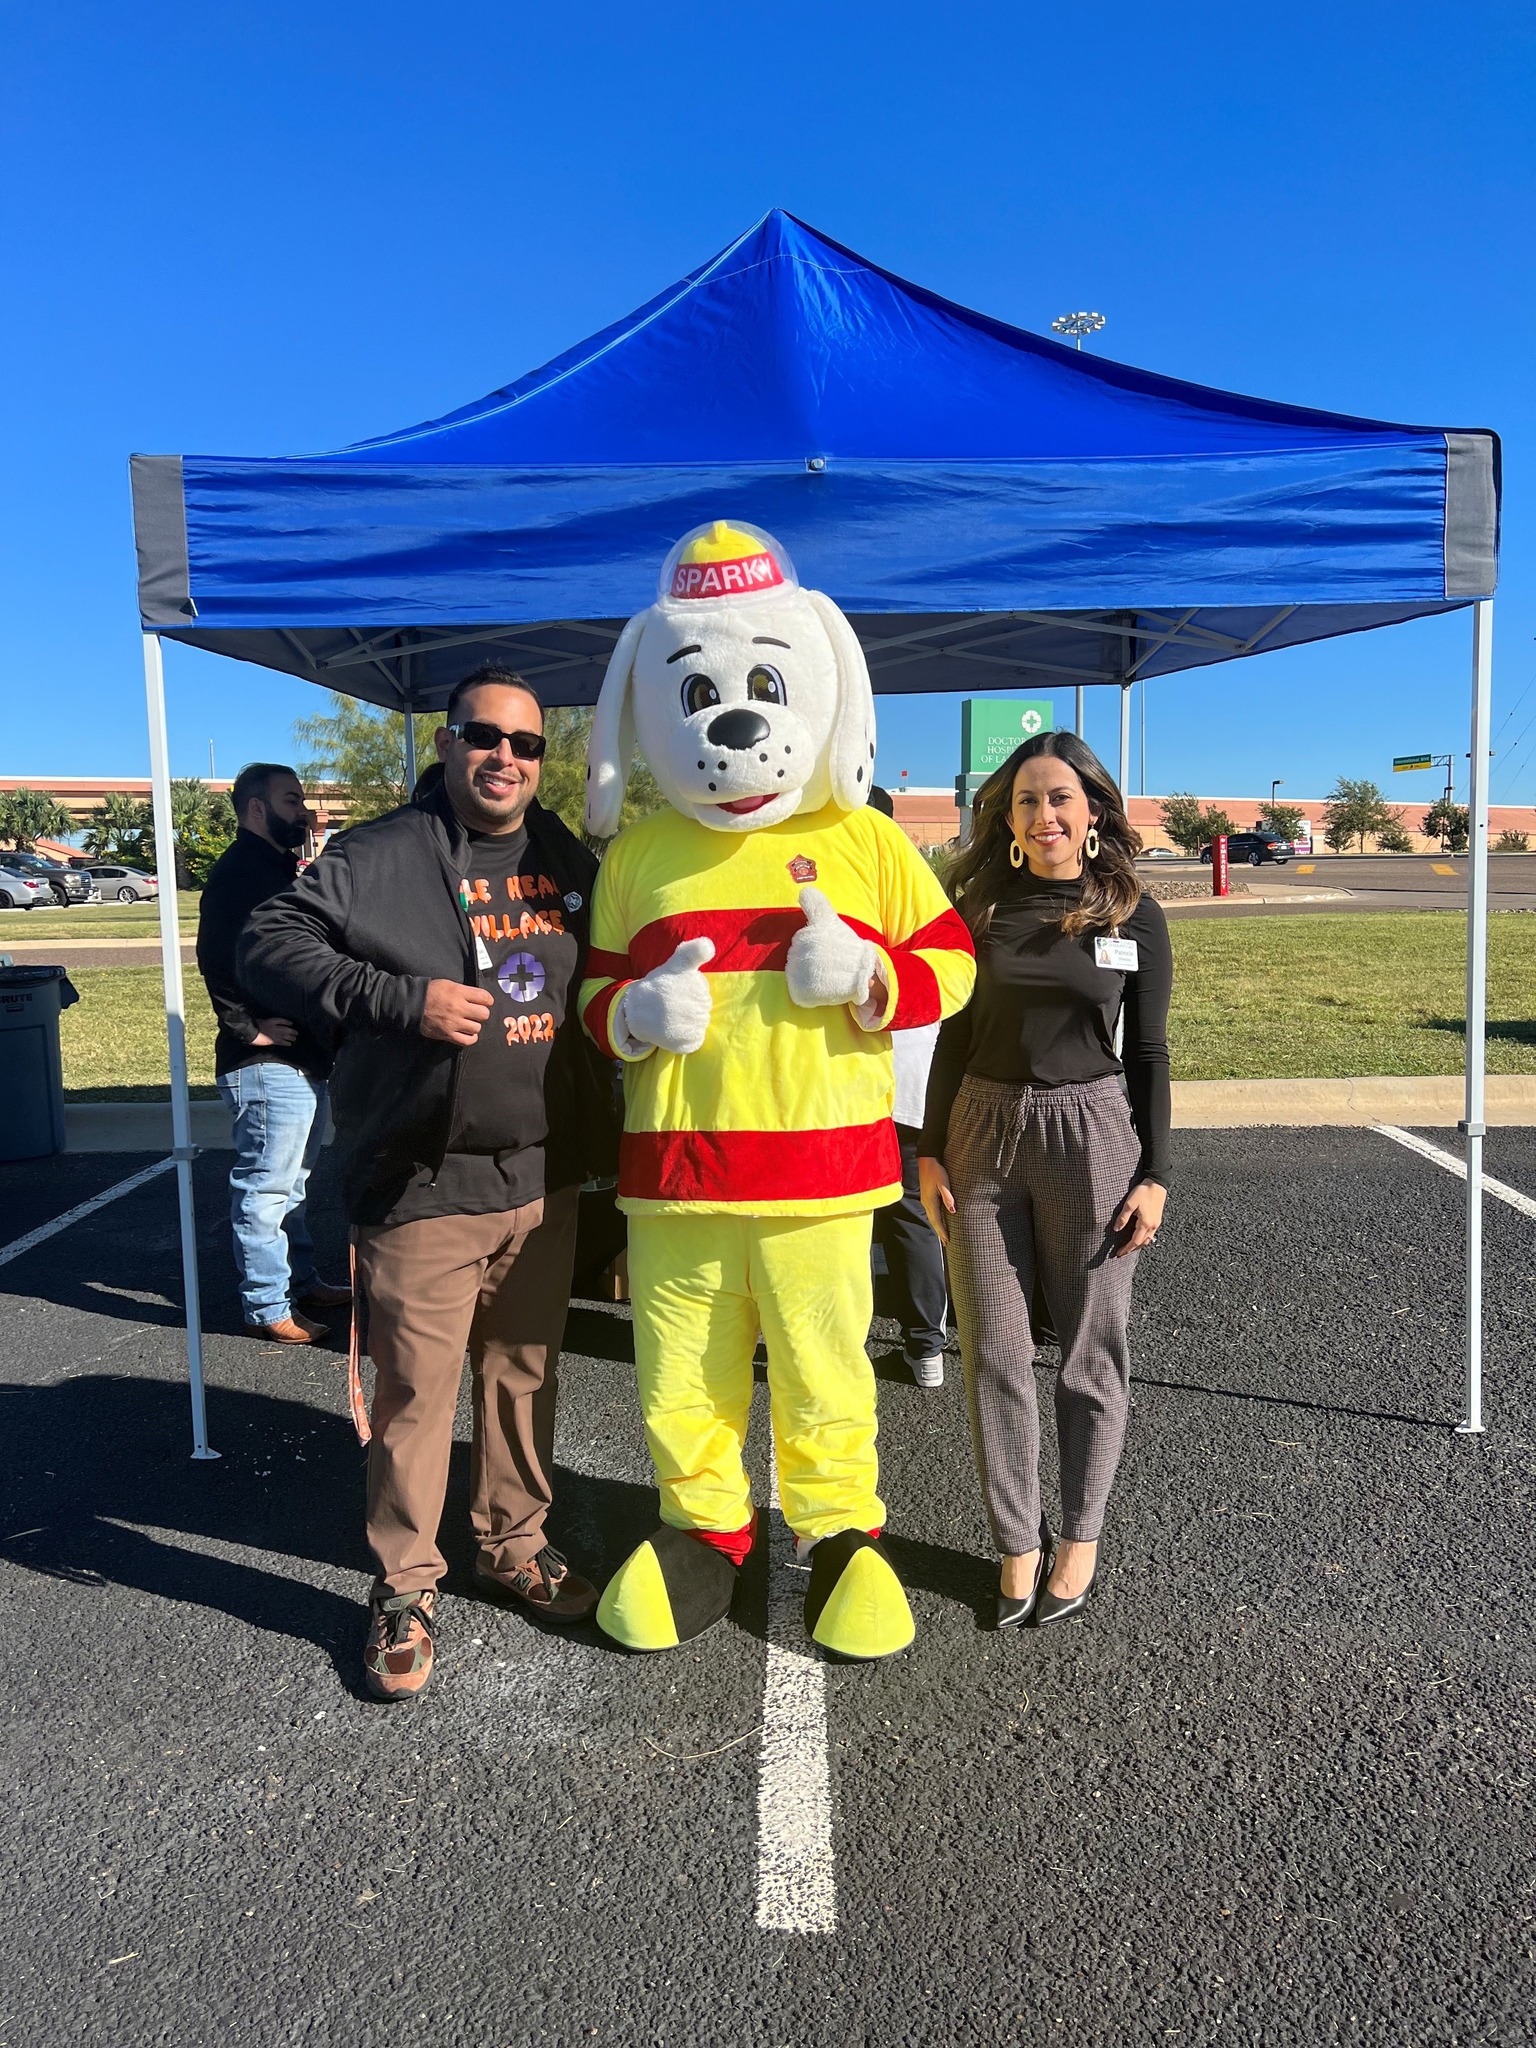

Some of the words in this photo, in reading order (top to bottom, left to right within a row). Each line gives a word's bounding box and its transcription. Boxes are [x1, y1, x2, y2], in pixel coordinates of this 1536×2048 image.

[676, 557, 773, 592] SPARKY
[987, 745, 1016, 754] HOSPI
[988, 737, 1027, 745] DOCTOR
[980, 755, 993, 763] OF
[459, 878, 492, 904] LE
[506, 874, 561, 901] HEA
[469, 910, 564, 943] VILLAGE
[0, 993, 33, 1004] RUTE
[503, 1012, 554, 1046] 2022
